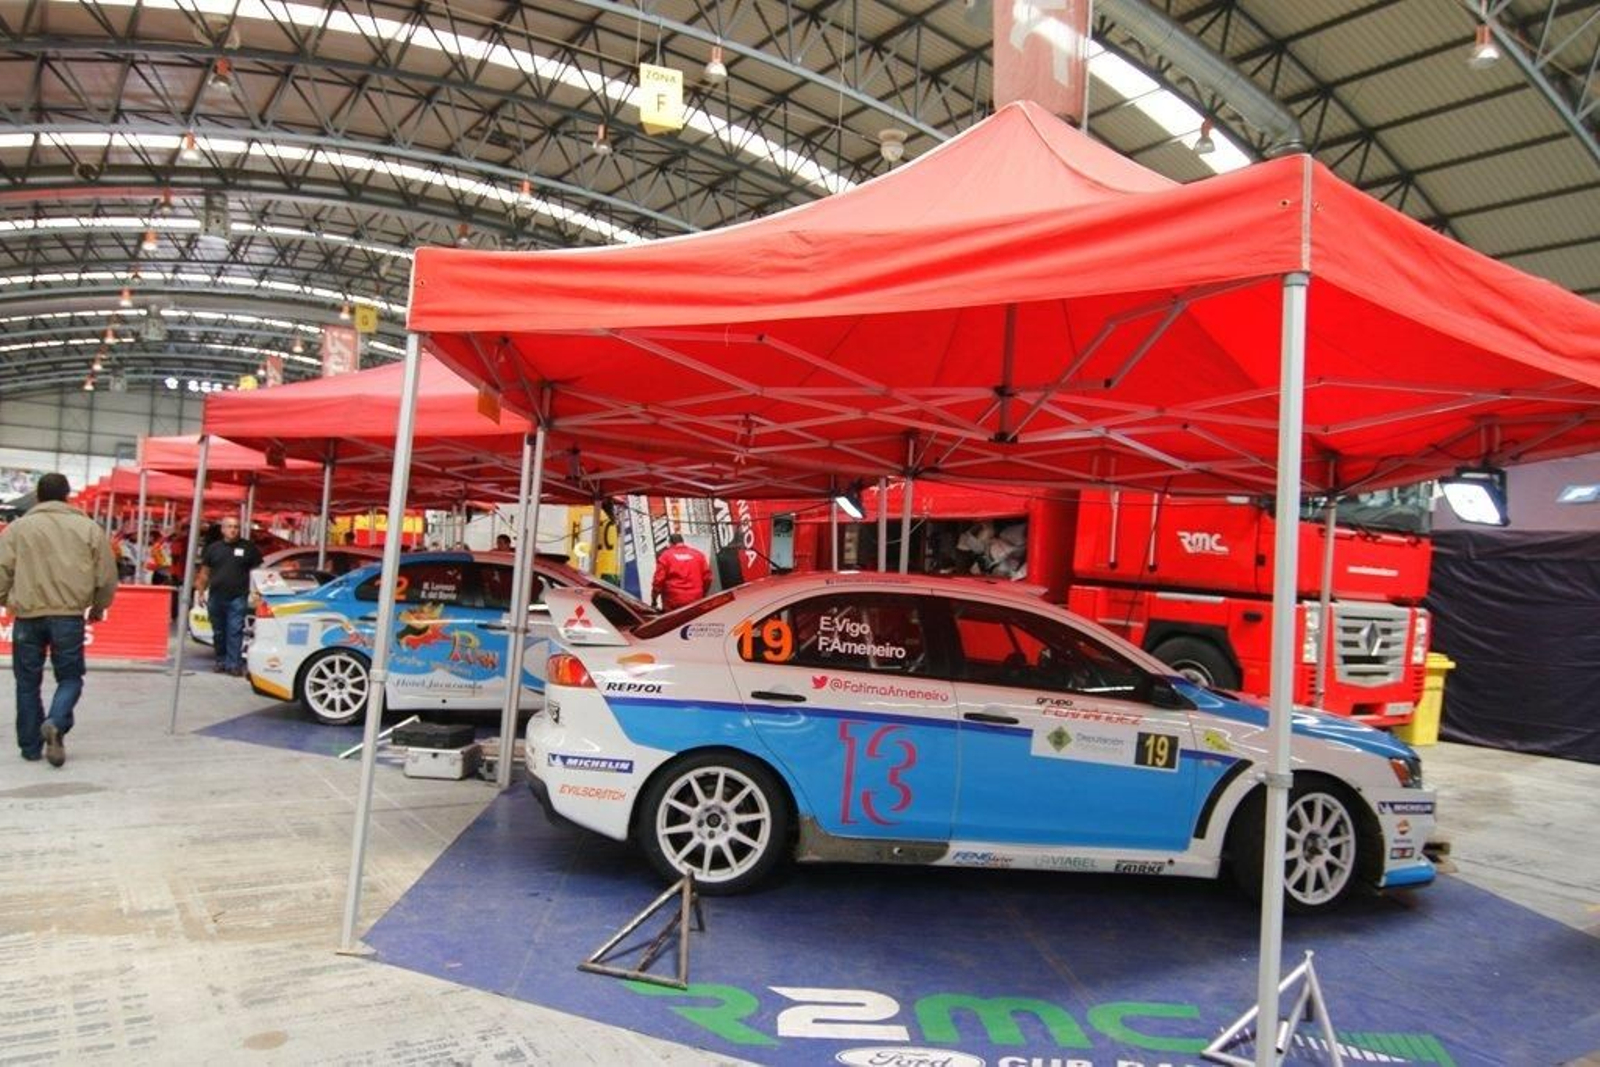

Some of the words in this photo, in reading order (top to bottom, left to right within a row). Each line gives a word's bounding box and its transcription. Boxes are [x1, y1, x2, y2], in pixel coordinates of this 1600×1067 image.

[646, 70, 676, 83] ZONA
[656, 93, 667, 113] F
[1176, 531, 1230, 554] RMC
[733, 616, 794, 662] 19
[817, 635, 906, 660] F.Ameneiro
[606, 681, 662, 694] REPSOL
[829, 677, 949, 702] @FatimaAmeneiro
[1036, 696, 1075, 707] grupo
[1144, 734, 1170, 767] 19
[566, 757, 631, 771] MICHELIN
[868, 1051, 953, 1067] Ford
